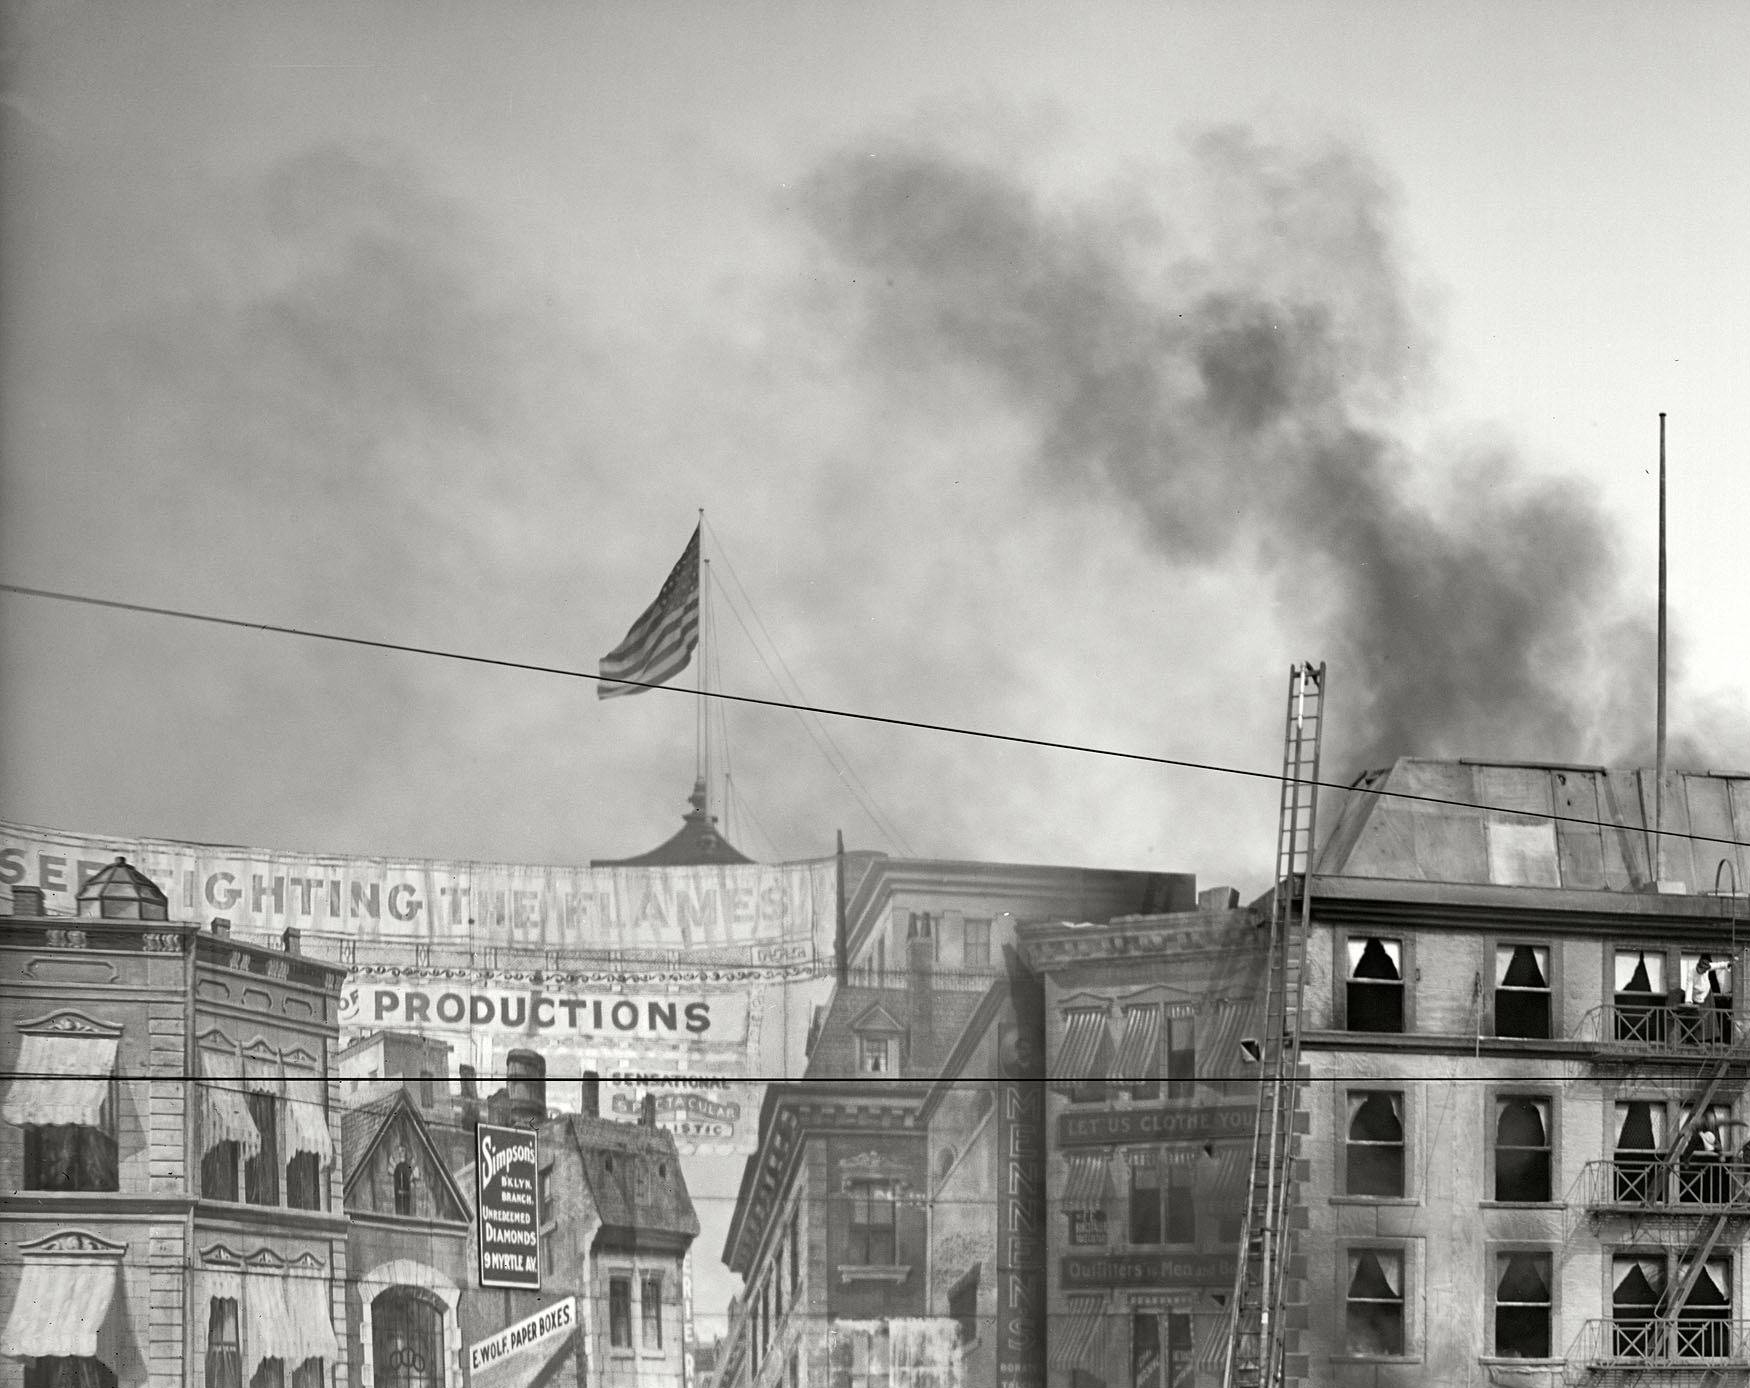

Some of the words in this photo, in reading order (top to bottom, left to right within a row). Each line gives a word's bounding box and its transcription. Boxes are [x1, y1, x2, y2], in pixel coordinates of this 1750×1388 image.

[440, 887, 540, 929] THE
[564, 887, 786, 930] FLAMES
[373, 989, 712, 1033] PRODUCTIONS
[611, 1072, 731, 1091] SENSATIONAL
[1068, 1120, 1097, 1136] LET
[1108, 1119, 1131, 1133] US
[1140, 1115, 1209, 1132] CLOTHE
[482, 1135, 535, 1190] Simpson's
[482, 1205, 531, 1225] UNREDEEMED
[485, 1222, 537, 1246] DIAMONDS
[484, 1251, 491, 1269] 9
[492, 1252, 524, 1272] MYRTLE
[525, 1255, 538, 1273] AV.
[1161, 1261, 1193, 1277] Men
[683, 1254, 694, 1343] ERIE
[510, 1323, 537, 1348] PAPER
[539, 1304, 573, 1337] BOXES.
